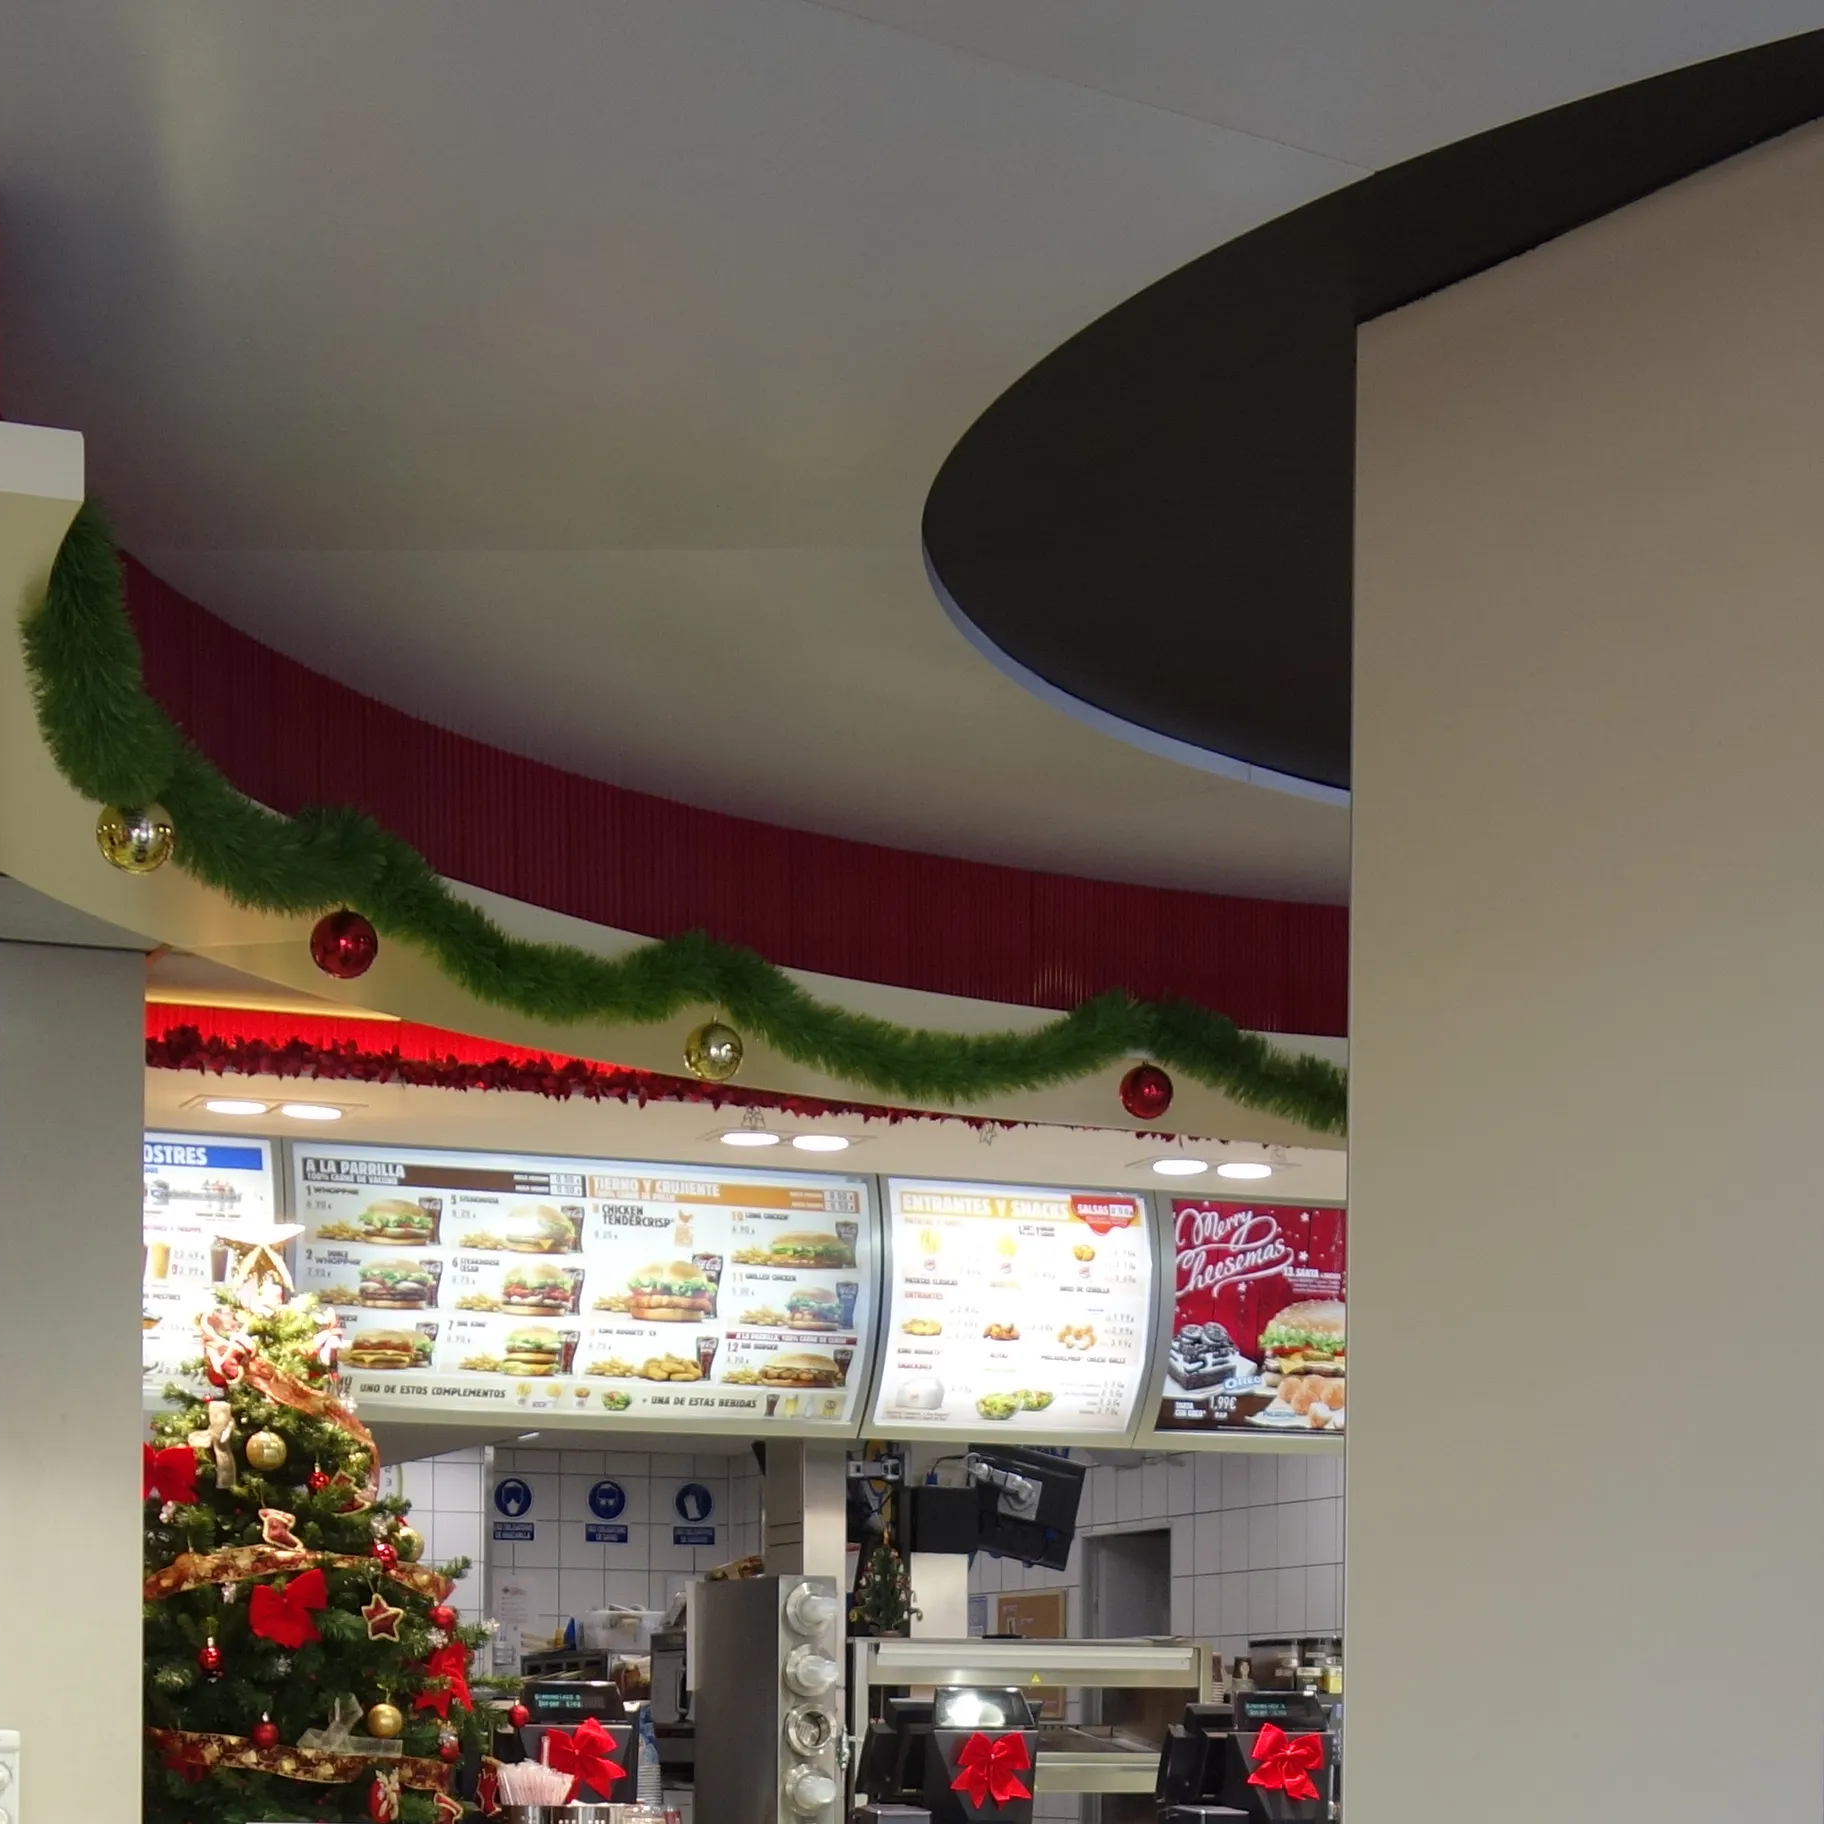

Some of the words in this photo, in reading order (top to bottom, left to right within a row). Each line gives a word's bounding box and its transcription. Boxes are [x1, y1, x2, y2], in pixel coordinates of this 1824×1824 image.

[144, 1144, 208, 1166] OSTRES
[306, 1159, 315, 1173] A
[320, 1160, 336, 1175] LA
[341, 1161, 405, 1179] PARRILLA
[602, 1204, 644, 1216] CHICKEN
[1176, 1208, 1275, 1251] Merry
[1176, 1238, 1287, 1298] Cheesemas
[359, 1384, 381, 1394] UNO
[384, 1385, 397, 1395] DE
[399, 1385, 429, 1396] ESTOS
[431, 1386, 507, 1399] COMPLEMENTOS
[1225, 1377, 1263, 1391] OREO
[651, 1396, 671, 1406] UNA
[674, 1397, 686, 1407] DE
[688, 1398, 716, 1408] ESTAS
[718, 1398, 758, 1409] BEBIDAS
